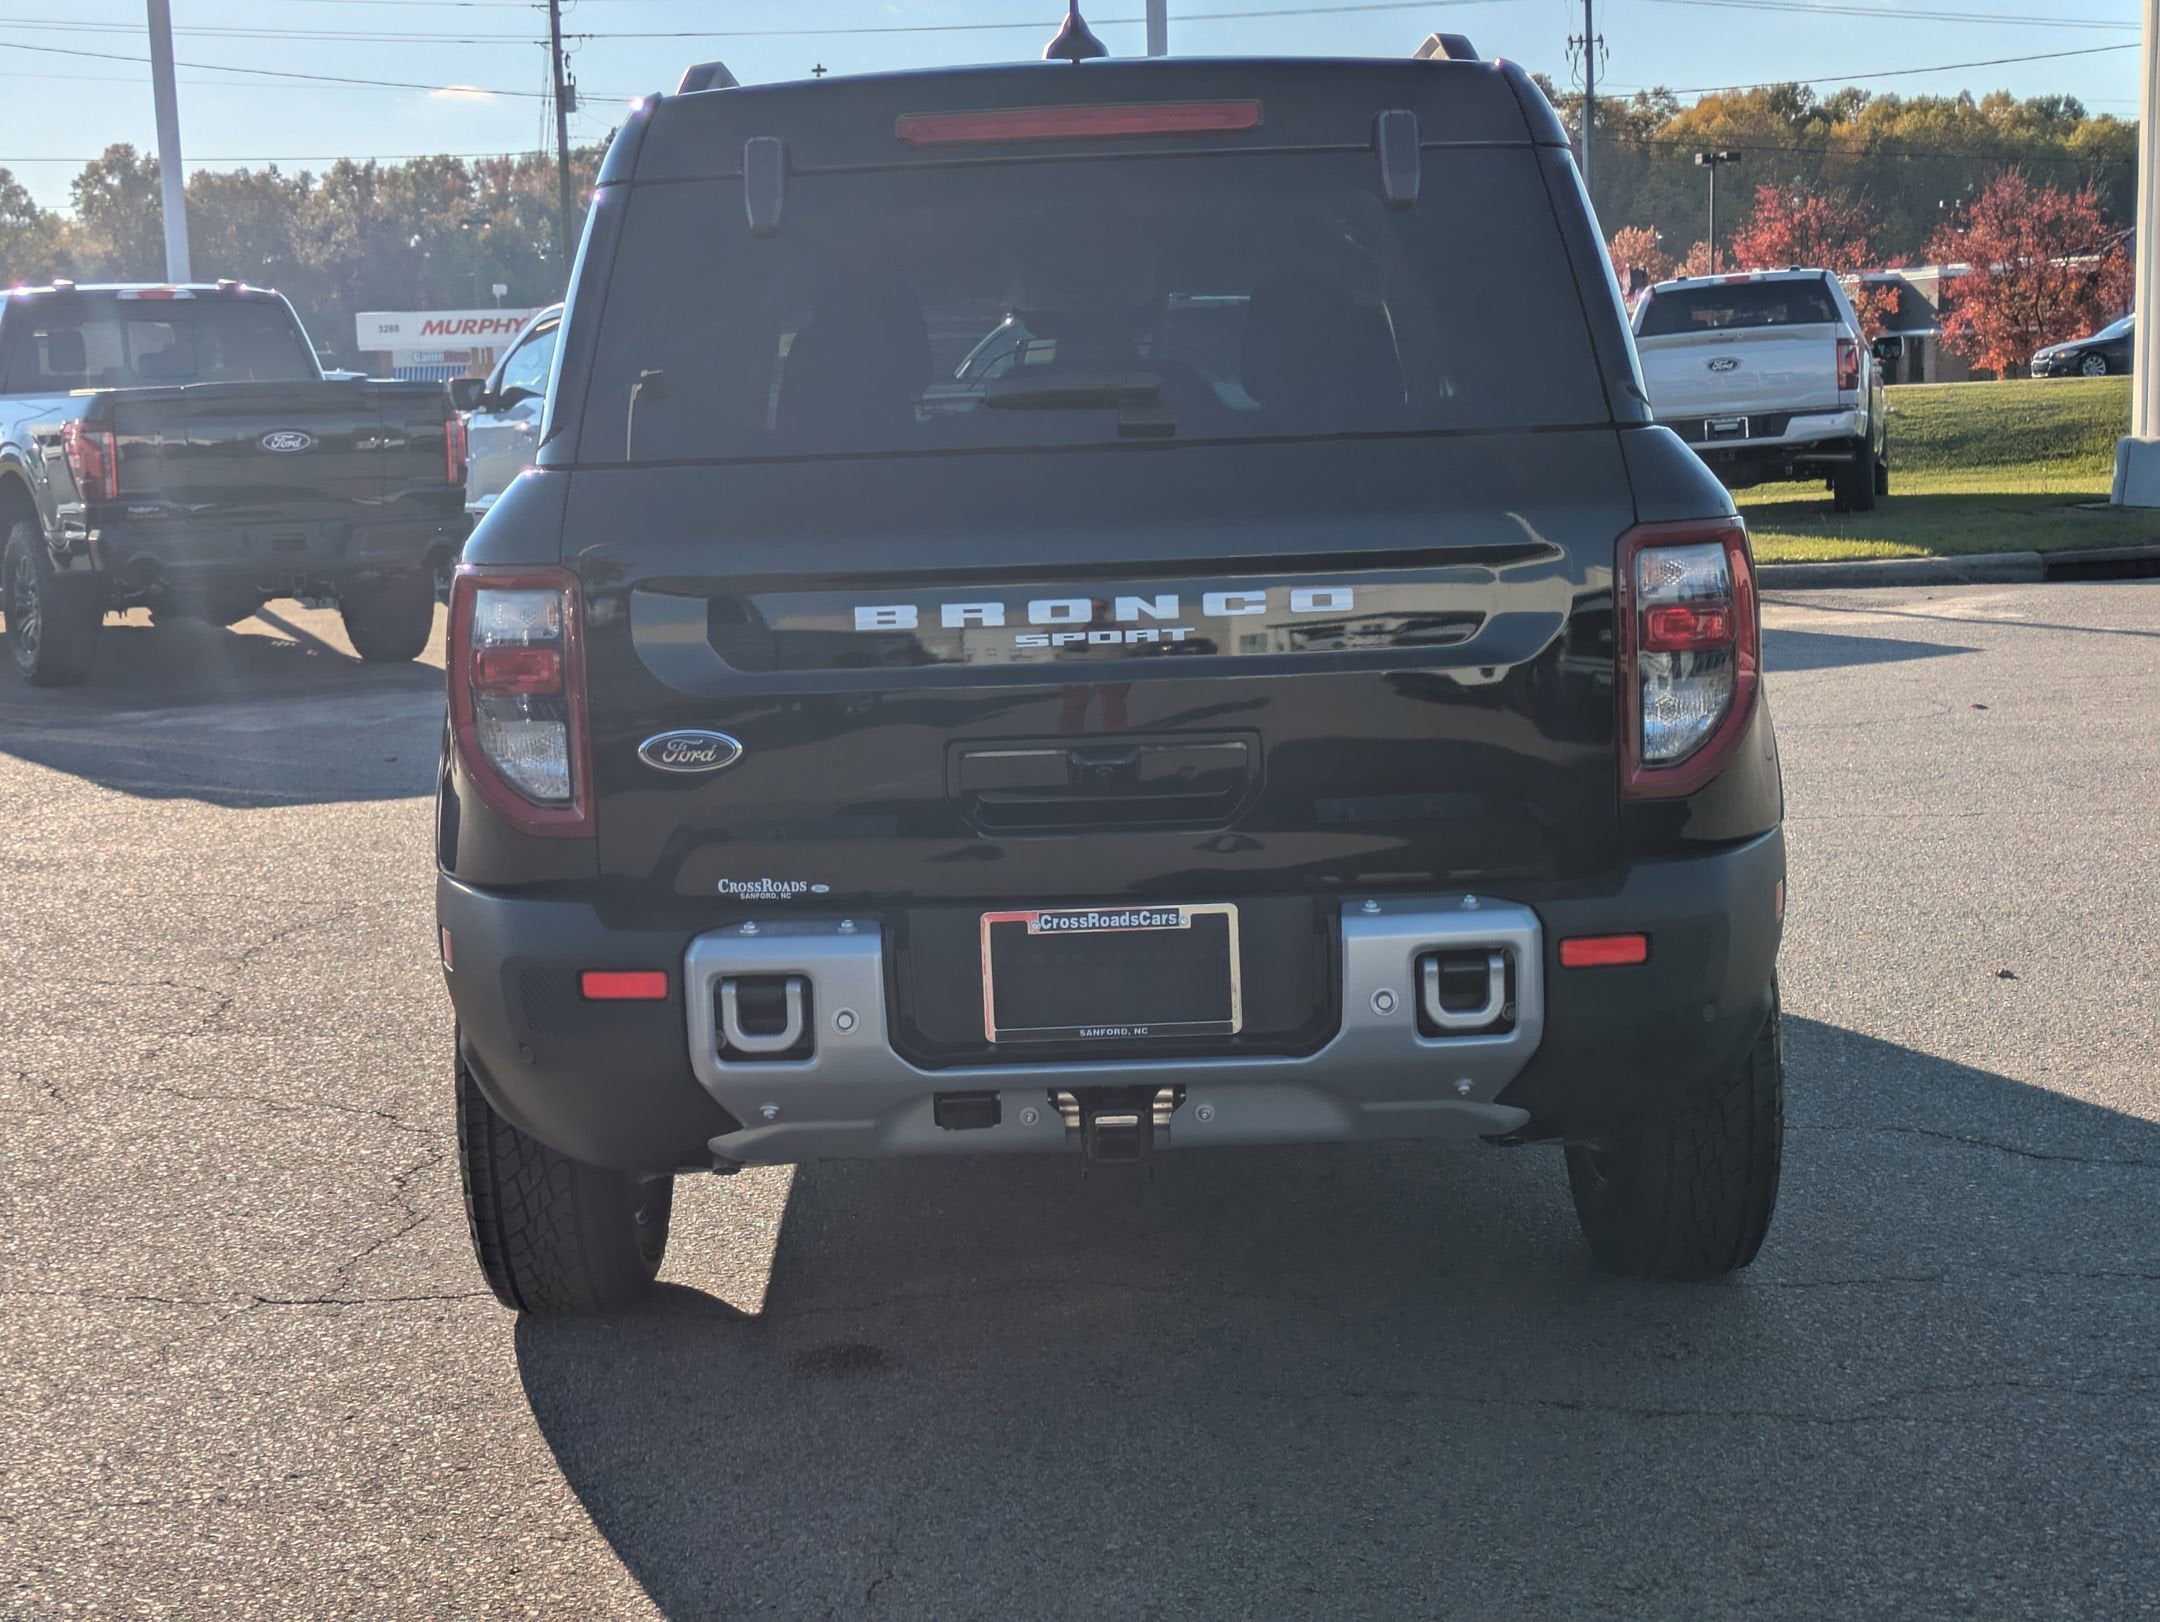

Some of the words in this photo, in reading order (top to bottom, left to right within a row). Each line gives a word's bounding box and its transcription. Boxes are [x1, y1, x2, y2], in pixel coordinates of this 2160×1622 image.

[420, 317, 528, 336] MURPHY
[271, 434, 302, 448] Ford
[854, 587, 1354, 631] BRONCO
[1015, 627, 1195, 648] SPORT
[662, 738, 717, 763] Ford
[740, 892, 779, 900] SANFORD,
[780, 892, 792, 900] NC
[1039, 910, 1177, 929] CrossRoadsCars
[1079, 1028, 1131, 1037] SANFORD,
[1134, 1026, 1148, 1035] NC
